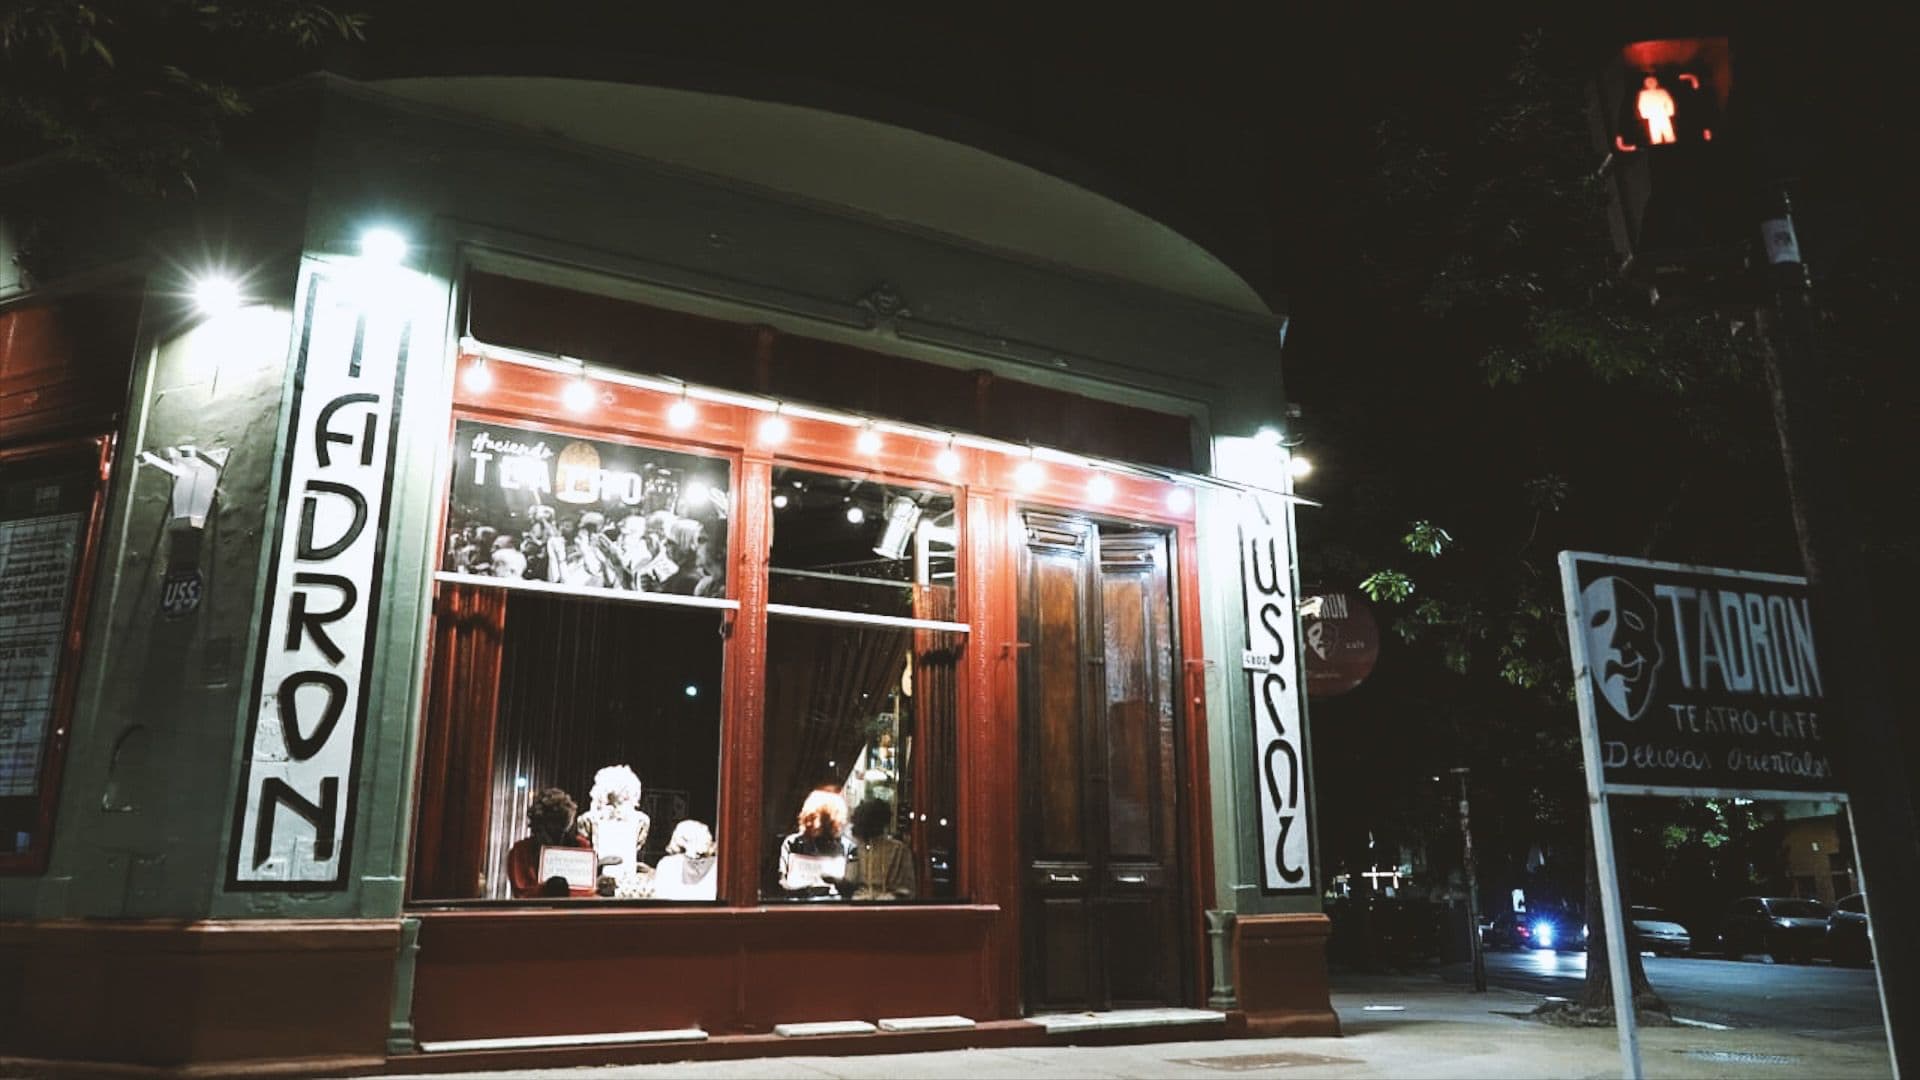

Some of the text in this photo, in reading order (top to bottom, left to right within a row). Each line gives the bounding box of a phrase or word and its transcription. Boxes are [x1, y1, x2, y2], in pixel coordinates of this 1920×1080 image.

[470, 452, 642, 505] TEARO
[1654, 583, 1823, 697] TADRON
[1603, 741, 1712, 769] Delicias
